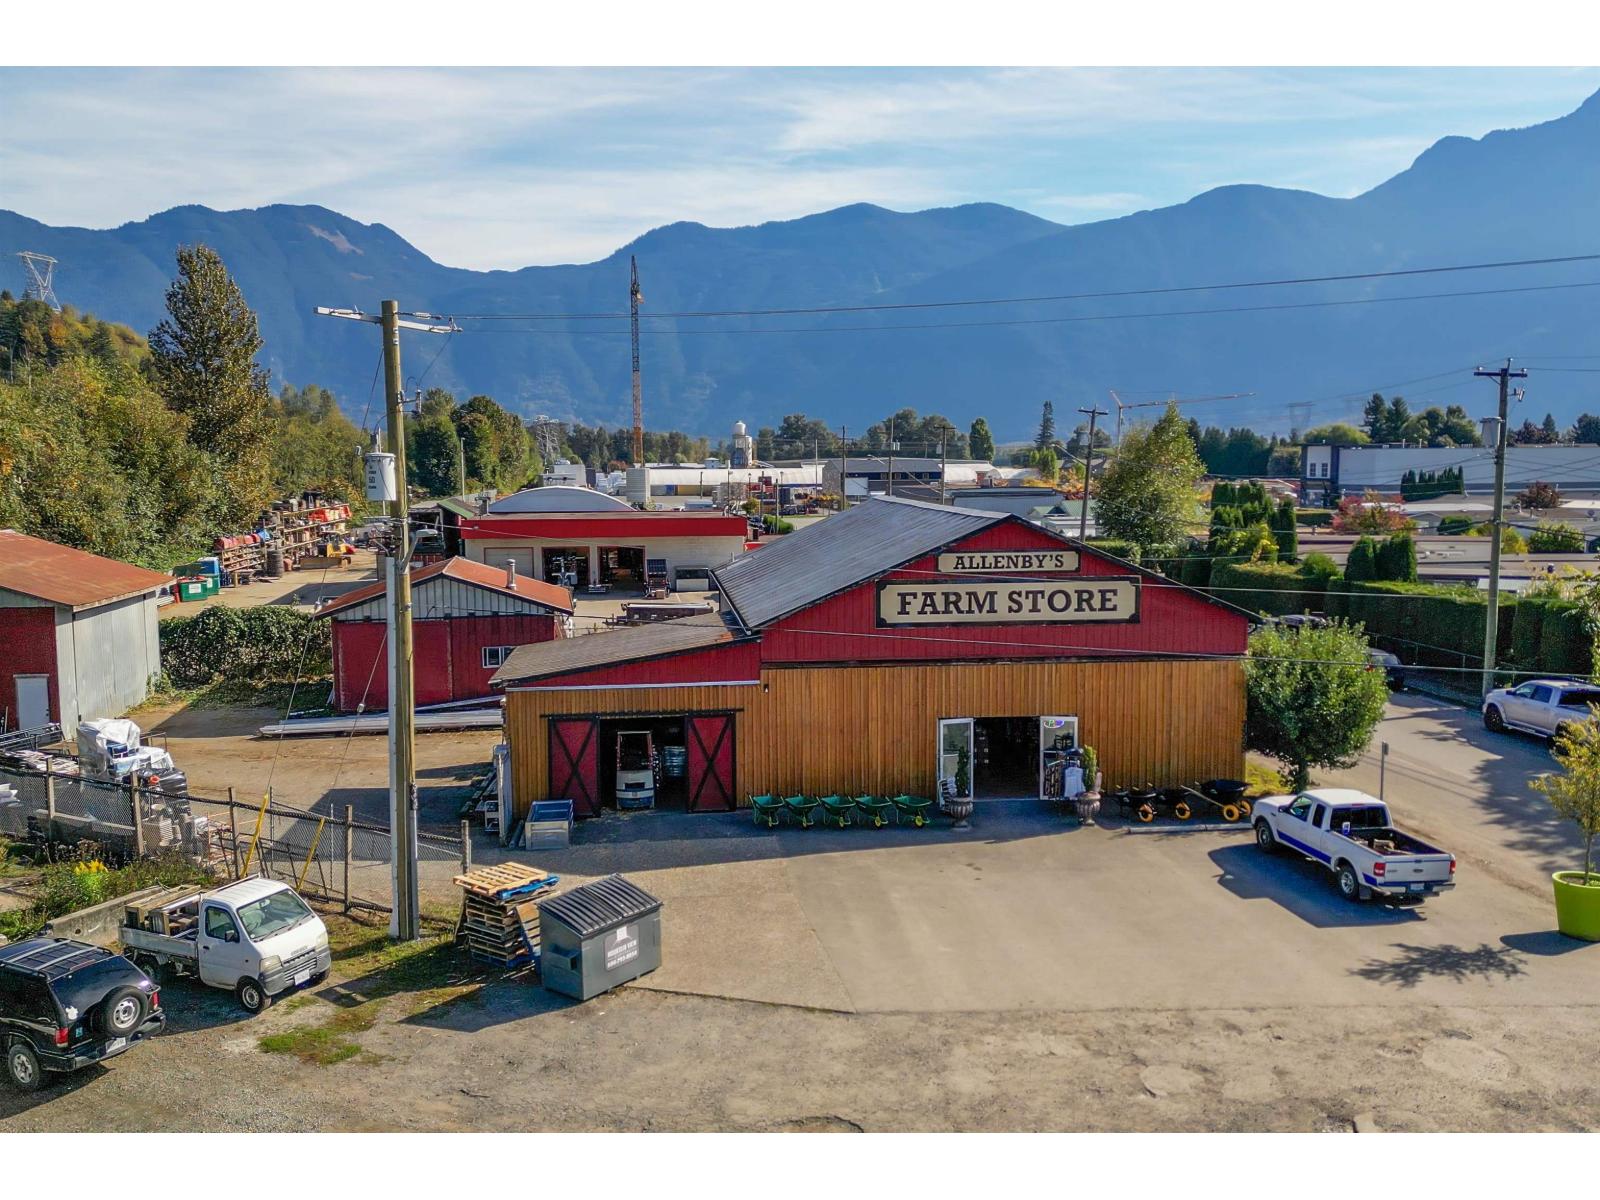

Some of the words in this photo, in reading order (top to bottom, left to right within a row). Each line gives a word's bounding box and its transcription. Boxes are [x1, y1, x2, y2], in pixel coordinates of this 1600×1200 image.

[953, 554, 1064, 570] ALLENBY'S
[897, 591, 998, 616] FARM
[1007, 588, 1118, 614] STORE
